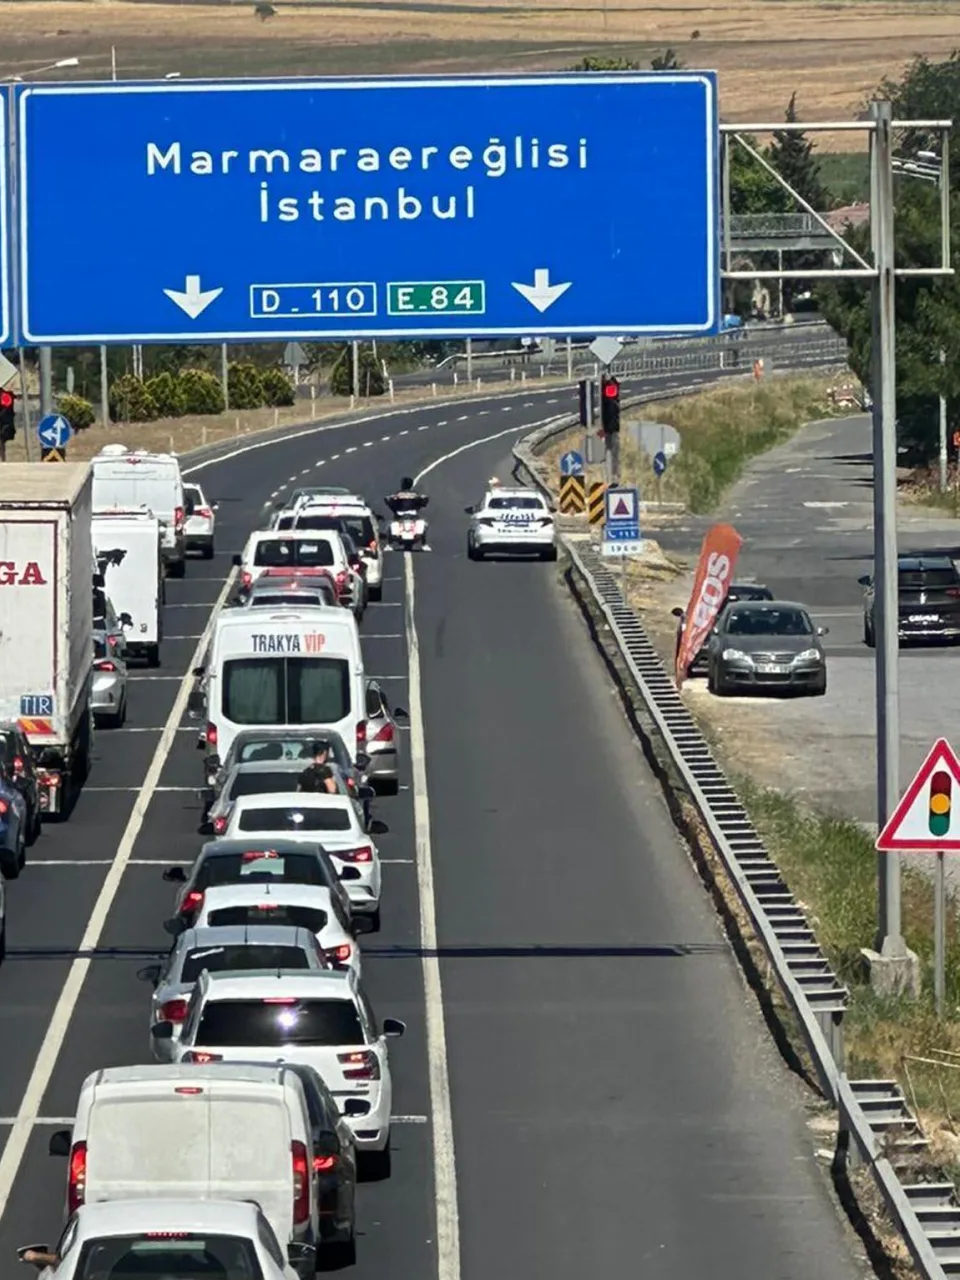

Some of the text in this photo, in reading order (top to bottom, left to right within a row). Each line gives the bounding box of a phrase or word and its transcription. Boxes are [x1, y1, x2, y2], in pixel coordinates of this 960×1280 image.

[146, 136, 588, 177] Marmaraereğlisi
[260, 181, 475, 222] İstanbul
[251, 629, 326, 653] TRAKYA VİP
[22, 696, 51, 714] TIR
